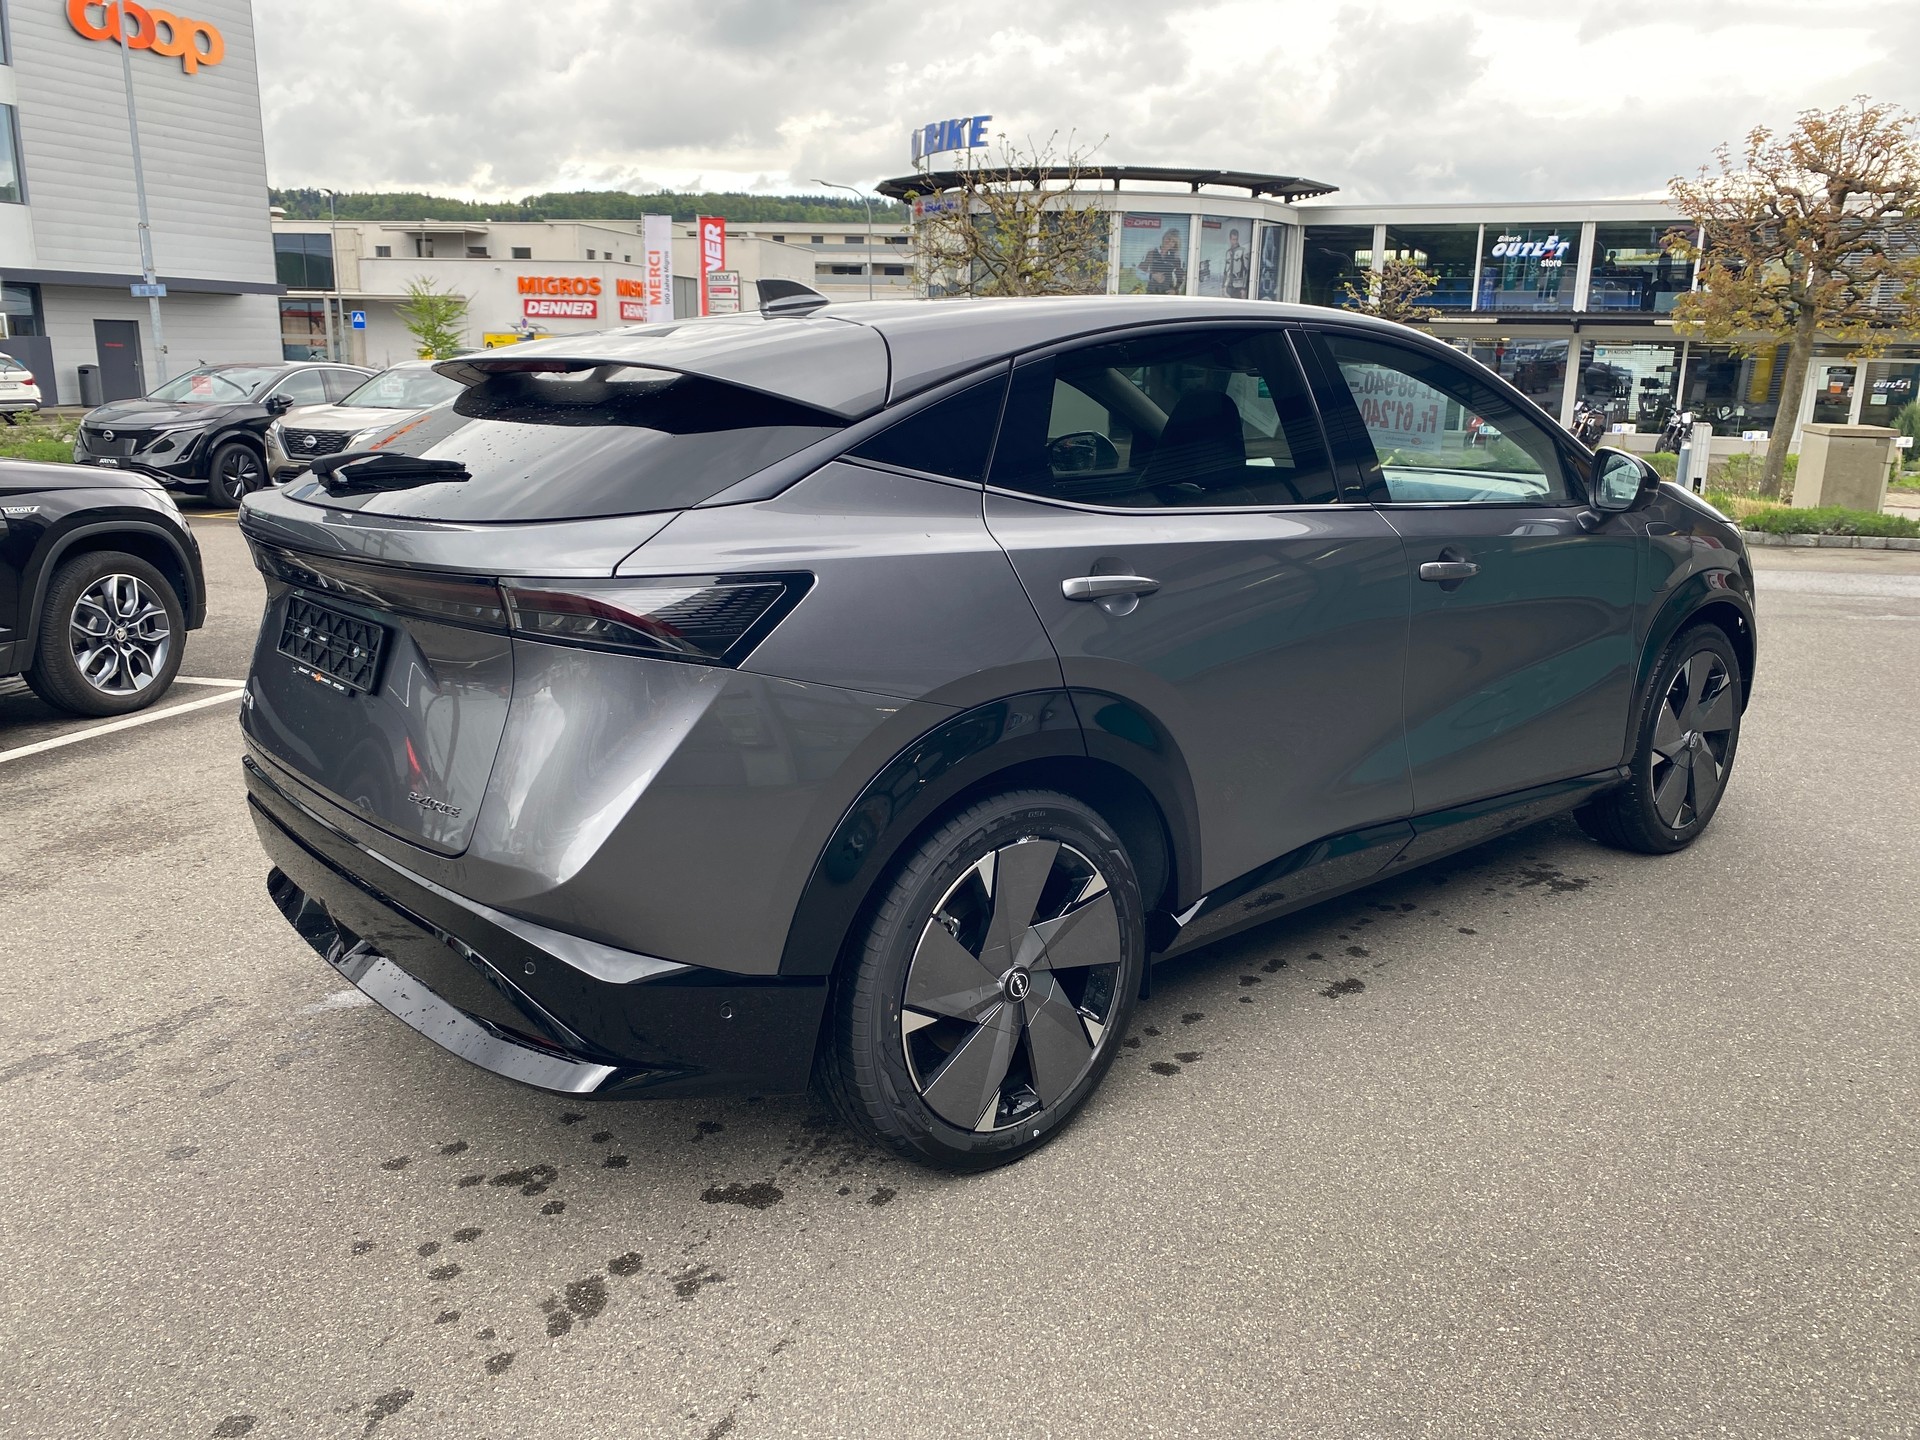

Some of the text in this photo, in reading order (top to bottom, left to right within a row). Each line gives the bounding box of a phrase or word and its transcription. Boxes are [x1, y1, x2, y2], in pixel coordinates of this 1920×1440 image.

[66, 0, 225, 74] coop
[924, 115, 993, 156] BIKE
[704, 223, 723, 273] VER
[1491, 235, 1570, 257] OUTLET
[663, 251, 671, 271] Migros
[1540, 258, 1562, 267] store
[517, 276, 602, 296] MIGROS
[648, 250, 662, 306] MERCI
[616, 279, 644, 298] MIGR
[526, 301, 595, 316] DENNER
[622, 303, 644, 318] DENN
[1873, 379, 1907, 388] OUTLET
[99, 457, 118, 465] ARIYA
